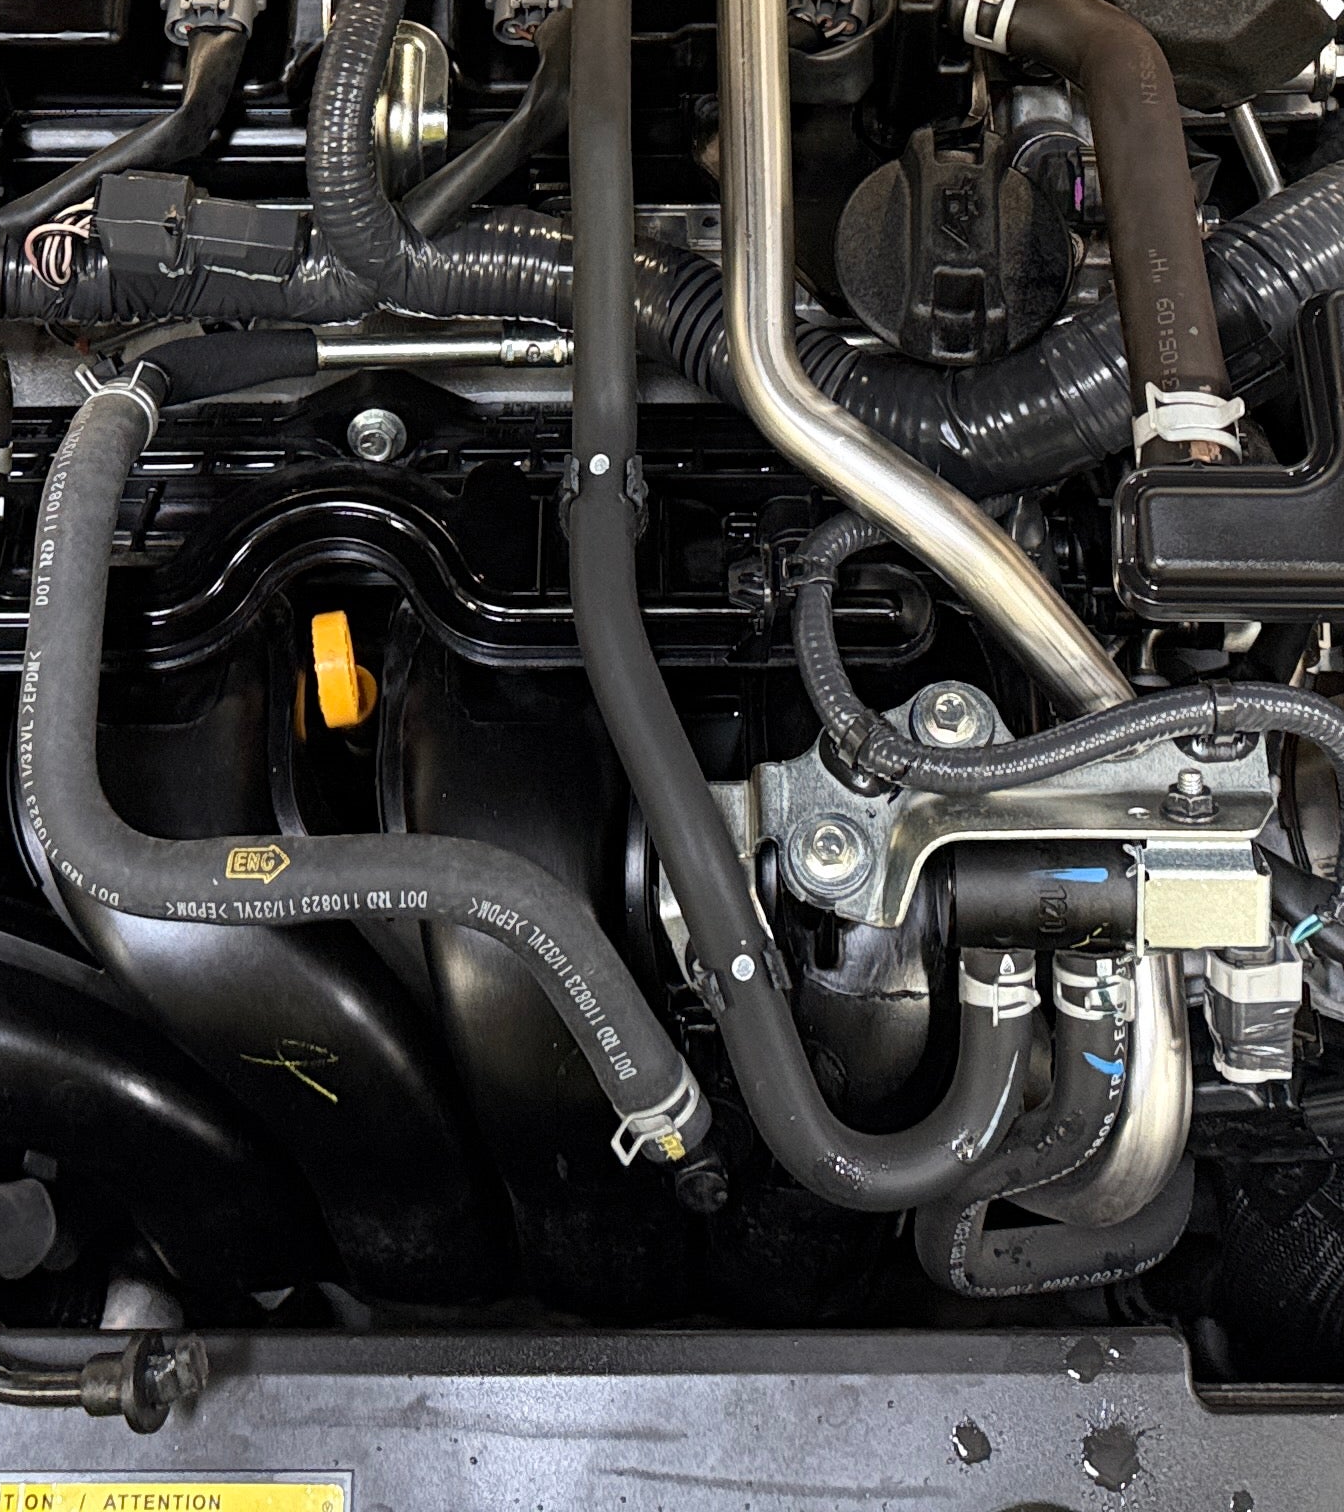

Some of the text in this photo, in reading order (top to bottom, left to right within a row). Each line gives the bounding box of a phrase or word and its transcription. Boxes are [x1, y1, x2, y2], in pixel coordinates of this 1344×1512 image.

[35, 576, 51, 606] DOT
[44, 471, 67, 533] 110823
[22, 650, 42, 713] >EPDM<
[26, 795, 59, 858] 110823
[233, 852, 276, 872] ENG
[89, 883, 120, 907] DOT
[302, 892, 359, 914] 110823
[399, 890, 428, 909] DOT
[166, 901, 228, 918] >EPDM<
[468, 896, 529, 936] >EPDM<
[564, 974, 606, 1026] 110823
[609, 1051, 638, 1081] DOT
[103, 1493, 222, 1510] ATTENTION
